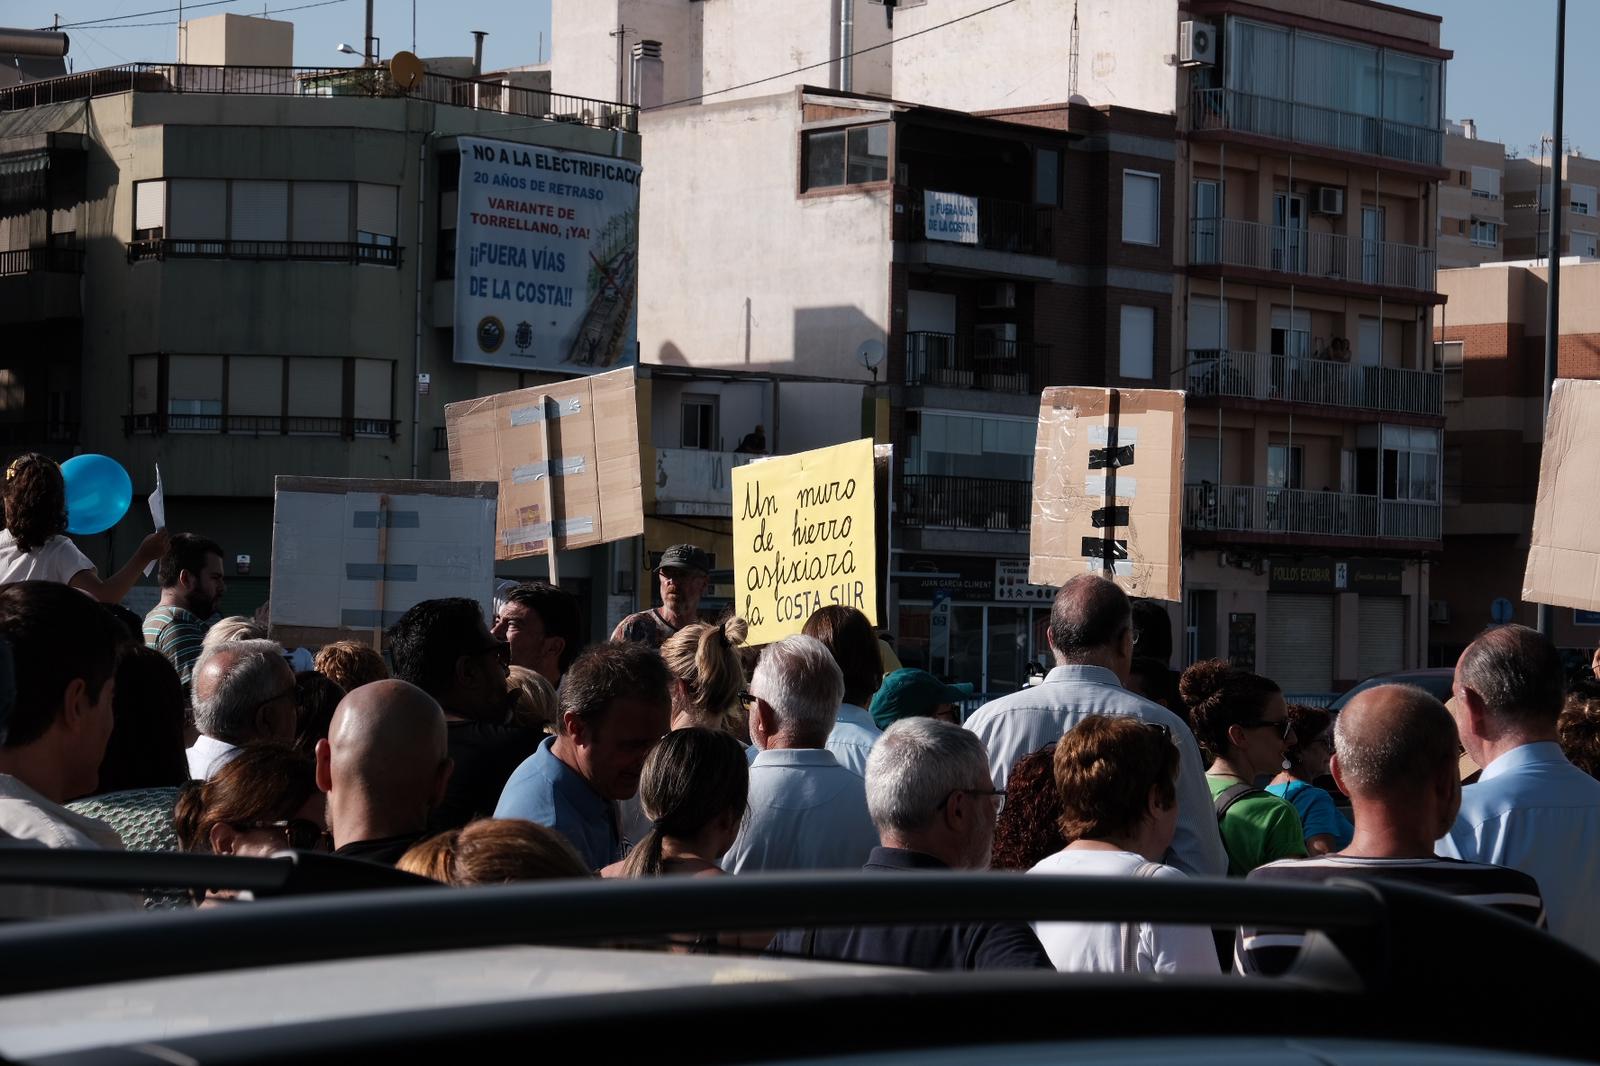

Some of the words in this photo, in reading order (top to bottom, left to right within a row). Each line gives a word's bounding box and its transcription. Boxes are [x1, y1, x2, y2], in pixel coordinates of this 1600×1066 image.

[473, 145, 495, 162] NO
[499, 148, 509, 164] A
[513, 150, 531, 167] LA
[473, 172, 489, 184] 20
[492, 173, 526, 189] AÑOS
[530, 179, 545, 192] DE
[549, 182, 604, 201] RETRASO
[488, 197, 554, 217] VARIANTE
[558, 207, 575, 220] DE
[470, 212, 562, 238] TORRELLANO,
[565, 226, 590, 240] ¡YA!
[470, 242, 527, 268] ¡¡FUERA
[532, 245, 566, 273] VÍAS
[470, 276, 488, 298] DE
[492, 278, 511, 300] LA
[516, 281, 573, 307] COSTA!!
[742, 481, 778, 520] Un
[797, 478, 856, 508] muro
[753, 518, 774, 553] de
[792, 509, 852, 547] hierro
[747, 541, 856, 600] asfixiará
[1273, 566, 1299, 582] POLLOS
[744, 594, 764, 626] la
[776, 590, 822, 623] COSTA
[830, 581, 864, 610] SUR
